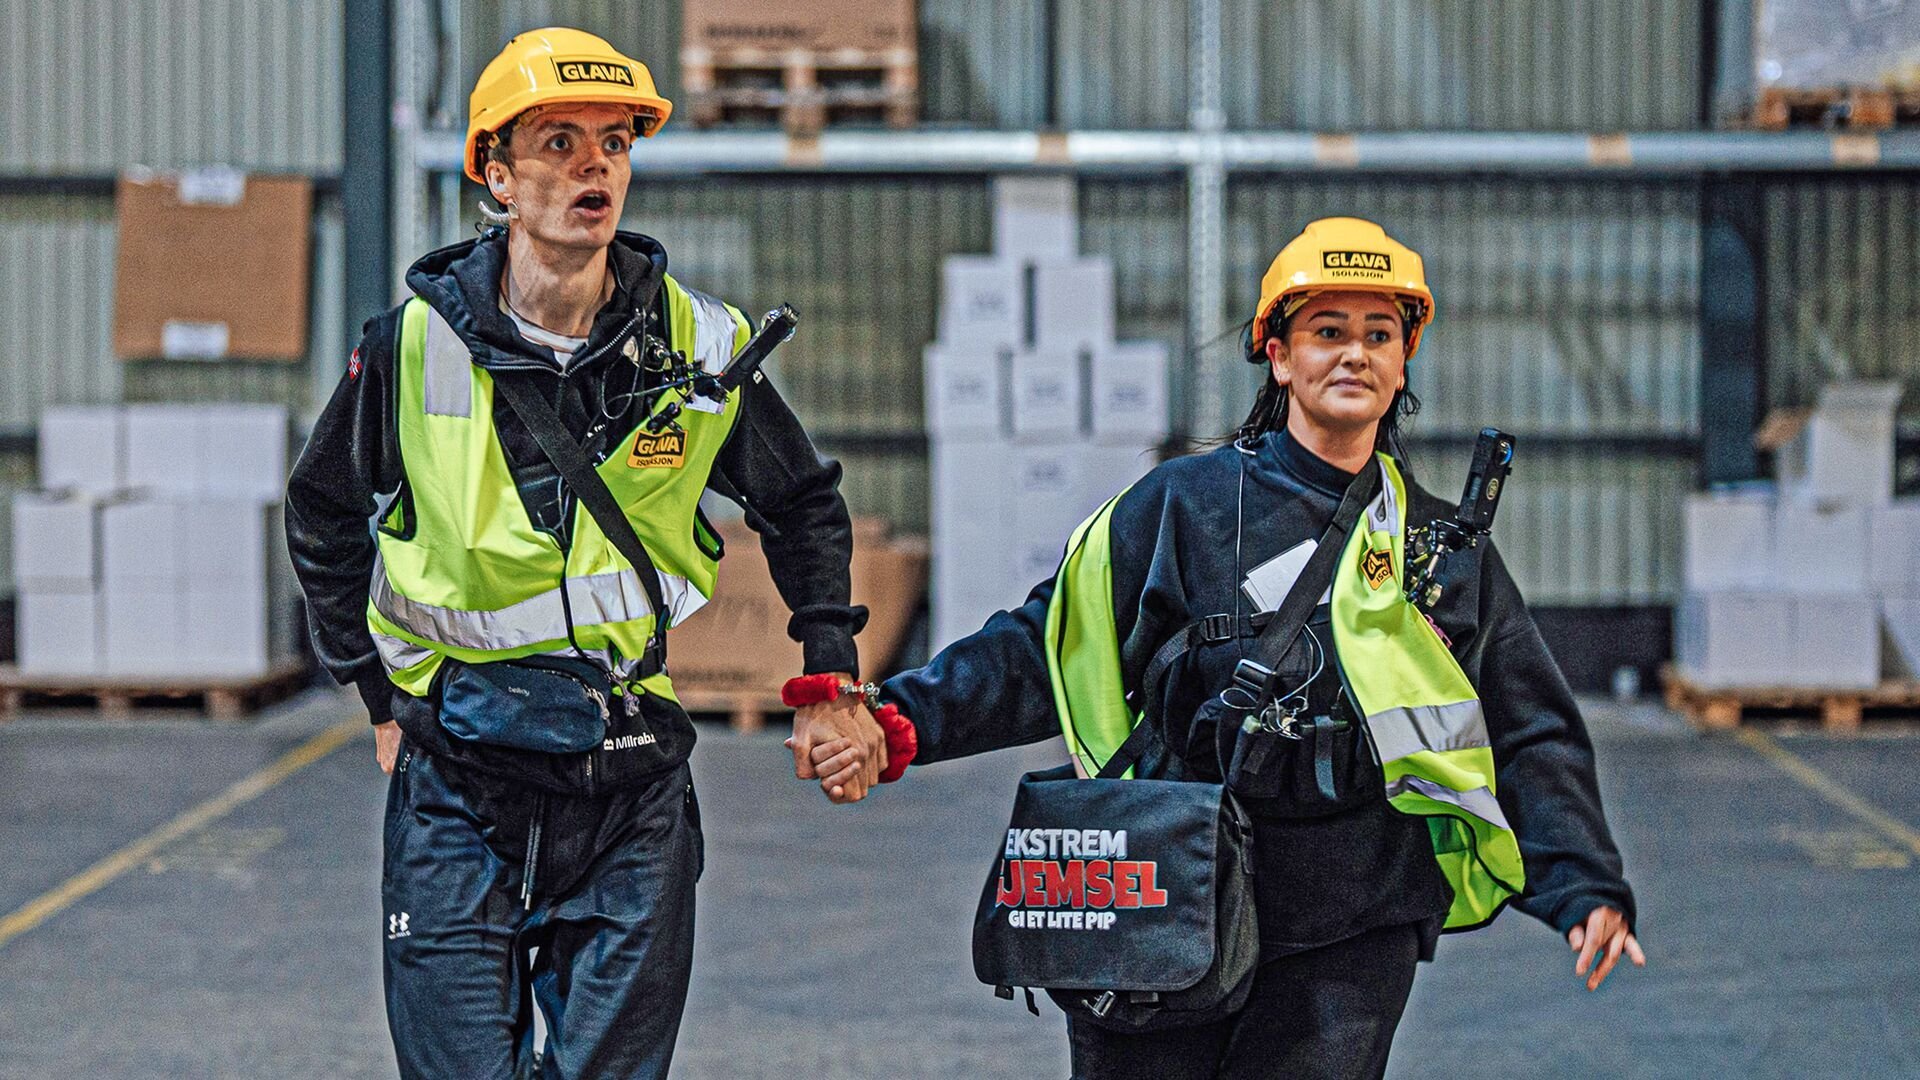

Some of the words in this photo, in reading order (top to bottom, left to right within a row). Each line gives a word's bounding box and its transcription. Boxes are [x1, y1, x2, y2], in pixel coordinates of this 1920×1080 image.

[562, 63, 632, 84] GLAVA
[1325, 252, 1388, 270] GLAVA
[1332, 270, 1384, 279] ISOLASJON
[1005, 828, 1128, 860] EKSTREM
[996, 859, 1168, 909] JEMSEL
[1008, 911, 1026, 929] GI
[1027, 911, 1046, 930] ET
[1047, 911, 1084, 931] LITE
[1085, 911, 1117, 931] PIP
